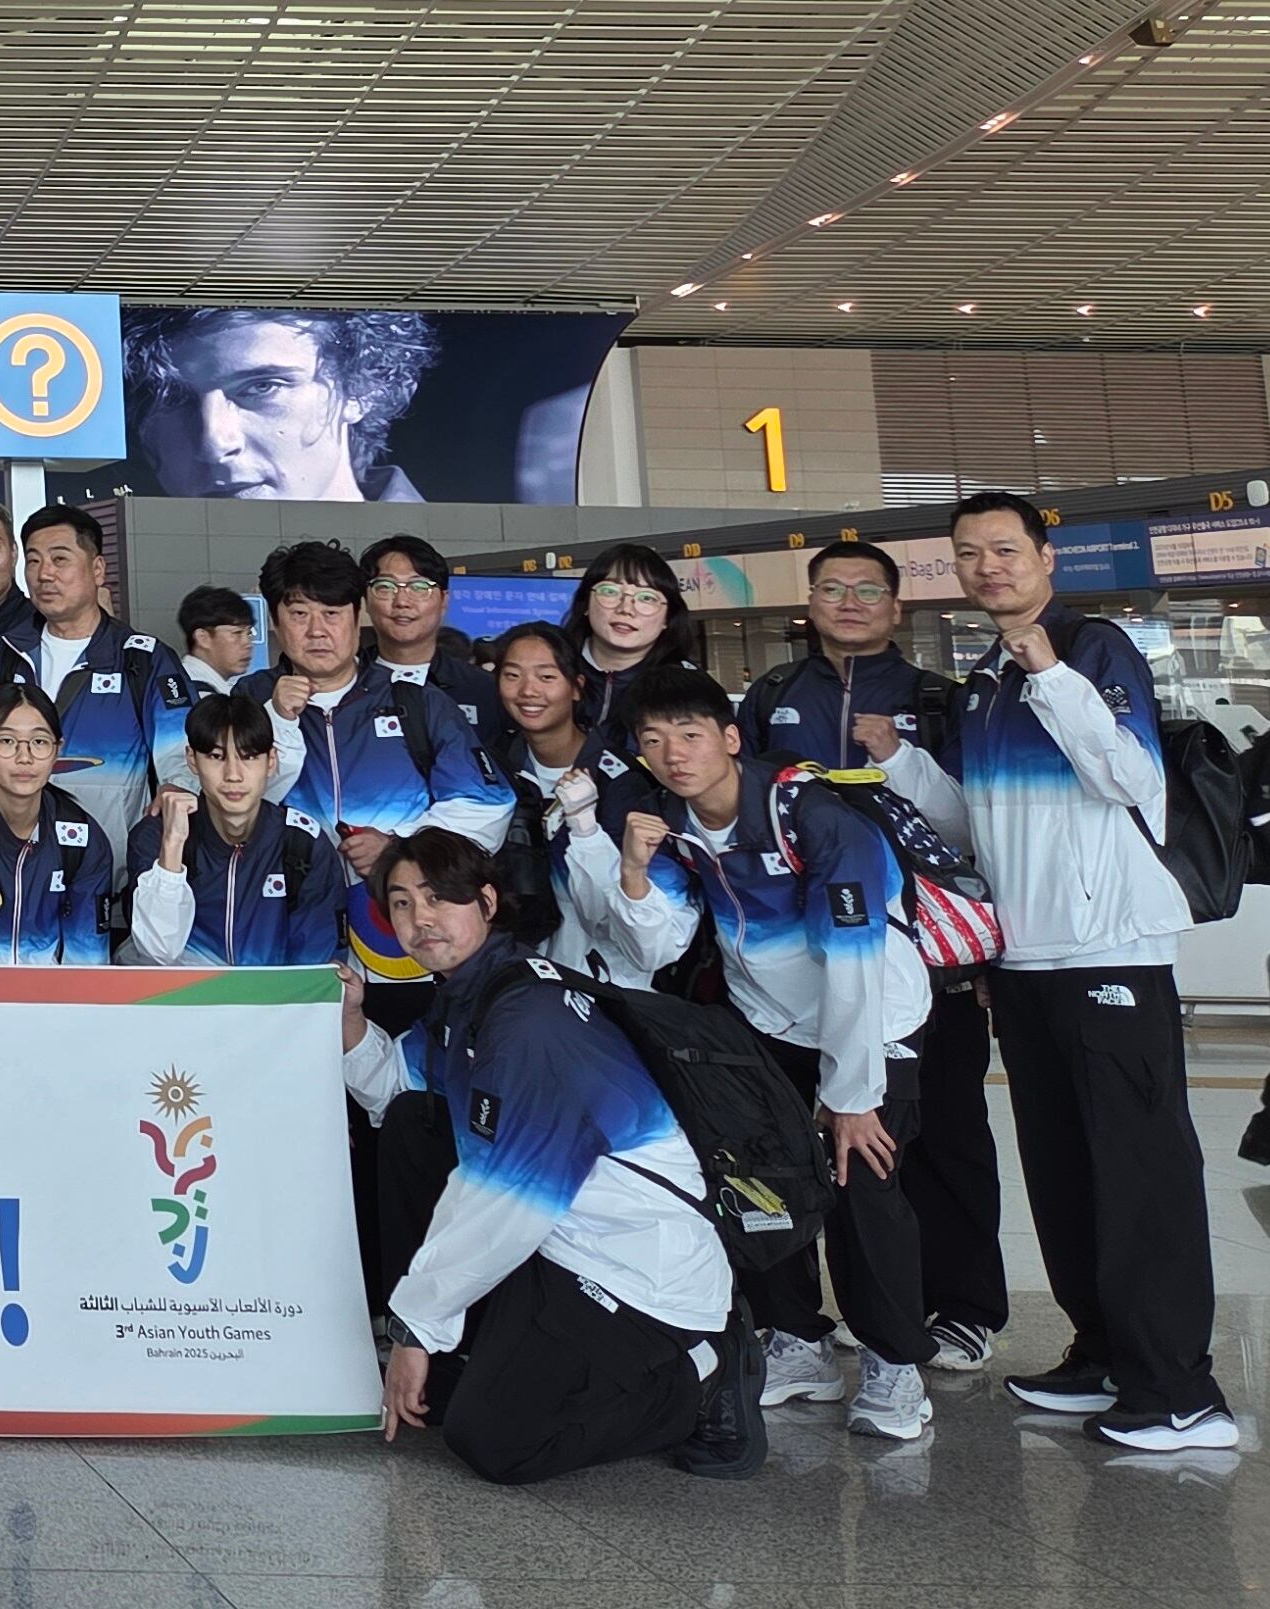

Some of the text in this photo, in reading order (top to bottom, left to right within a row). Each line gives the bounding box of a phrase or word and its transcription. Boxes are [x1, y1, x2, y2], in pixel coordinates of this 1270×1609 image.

[743, 407, 787, 492] 1
[1209, 490, 1234, 511] D5
[909, 560, 933, 580] Bag
[935, 559, 956, 575] Dro
[680, 578, 701, 592] EAN
[137, 1326, 175, 1340] Asian
[178, 1326, 220, 1341] Youth
[223, 1326, 272, 1341] Games
[146, 1348, 182, 1359] Bahrain
[184, 1348, 208, 1359] 2025
